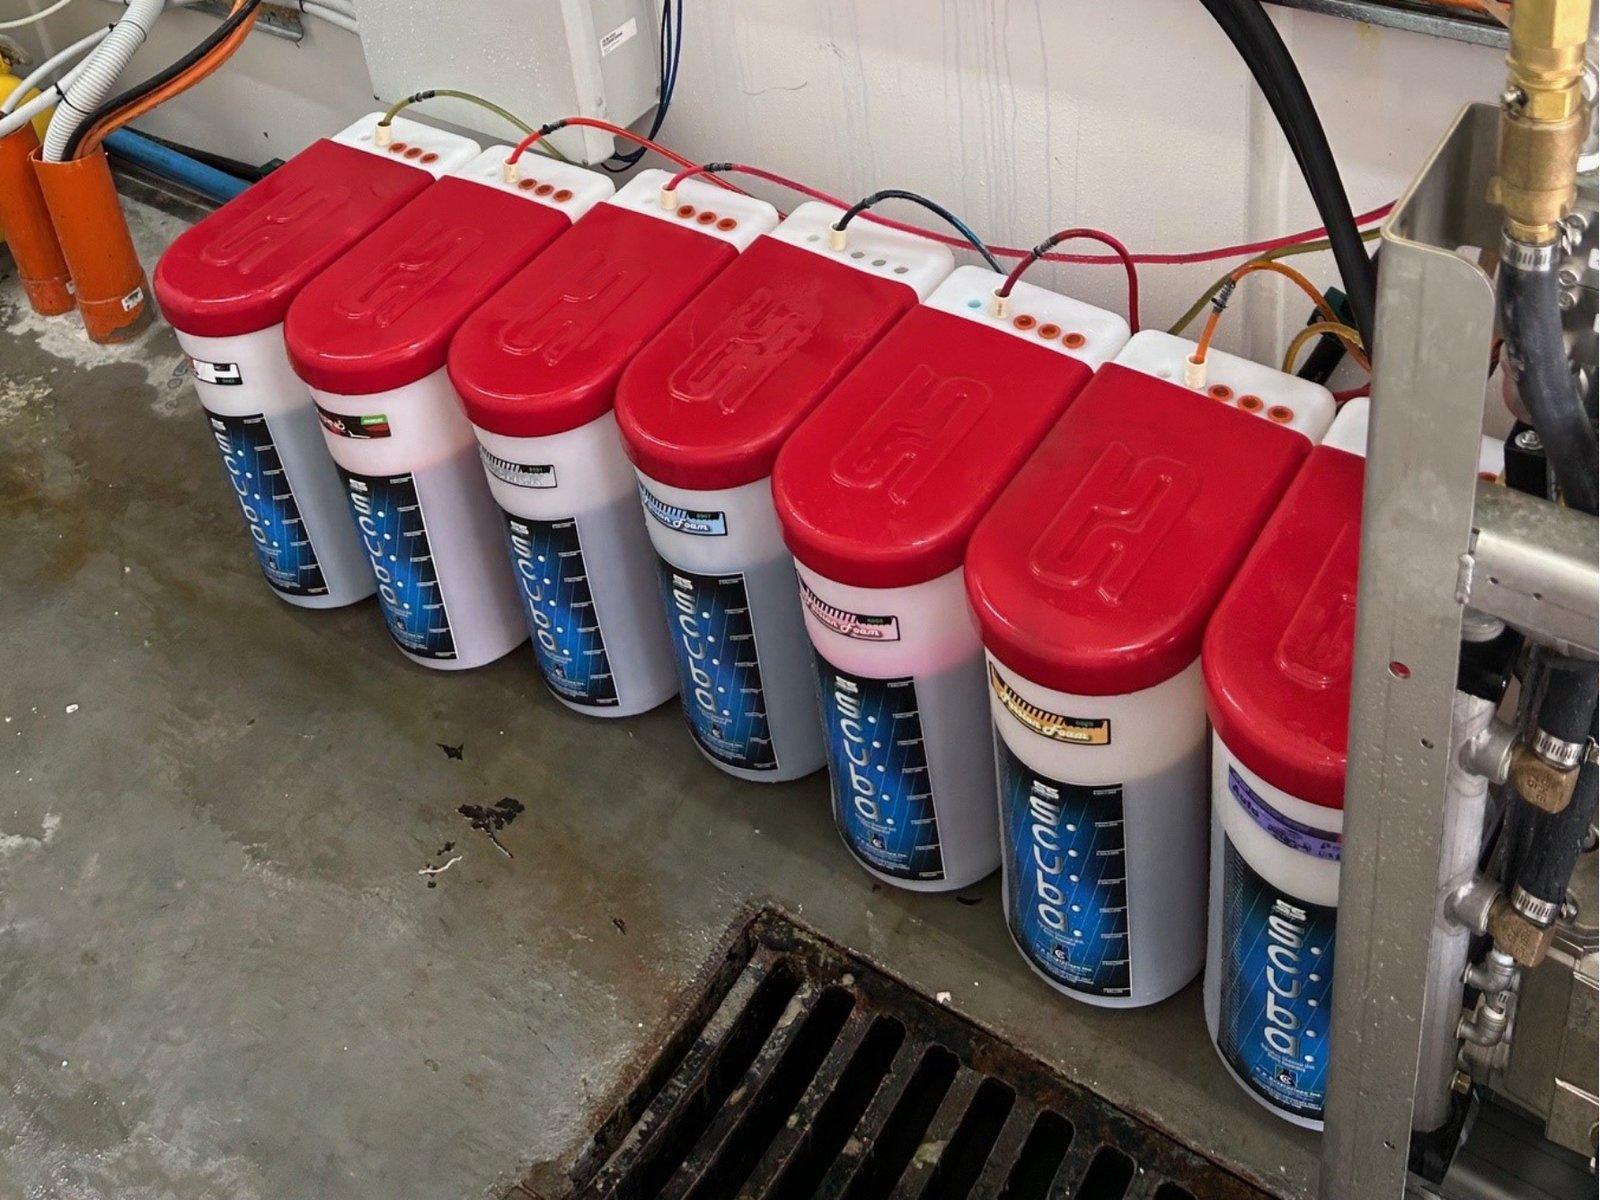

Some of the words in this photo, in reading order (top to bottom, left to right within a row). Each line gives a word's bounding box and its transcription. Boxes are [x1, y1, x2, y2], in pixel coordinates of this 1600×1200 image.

[673, 518, 710, 531] Foam
[840, 622, 881, 637] Foam
[1042, 724, 1091, 741] Foam
